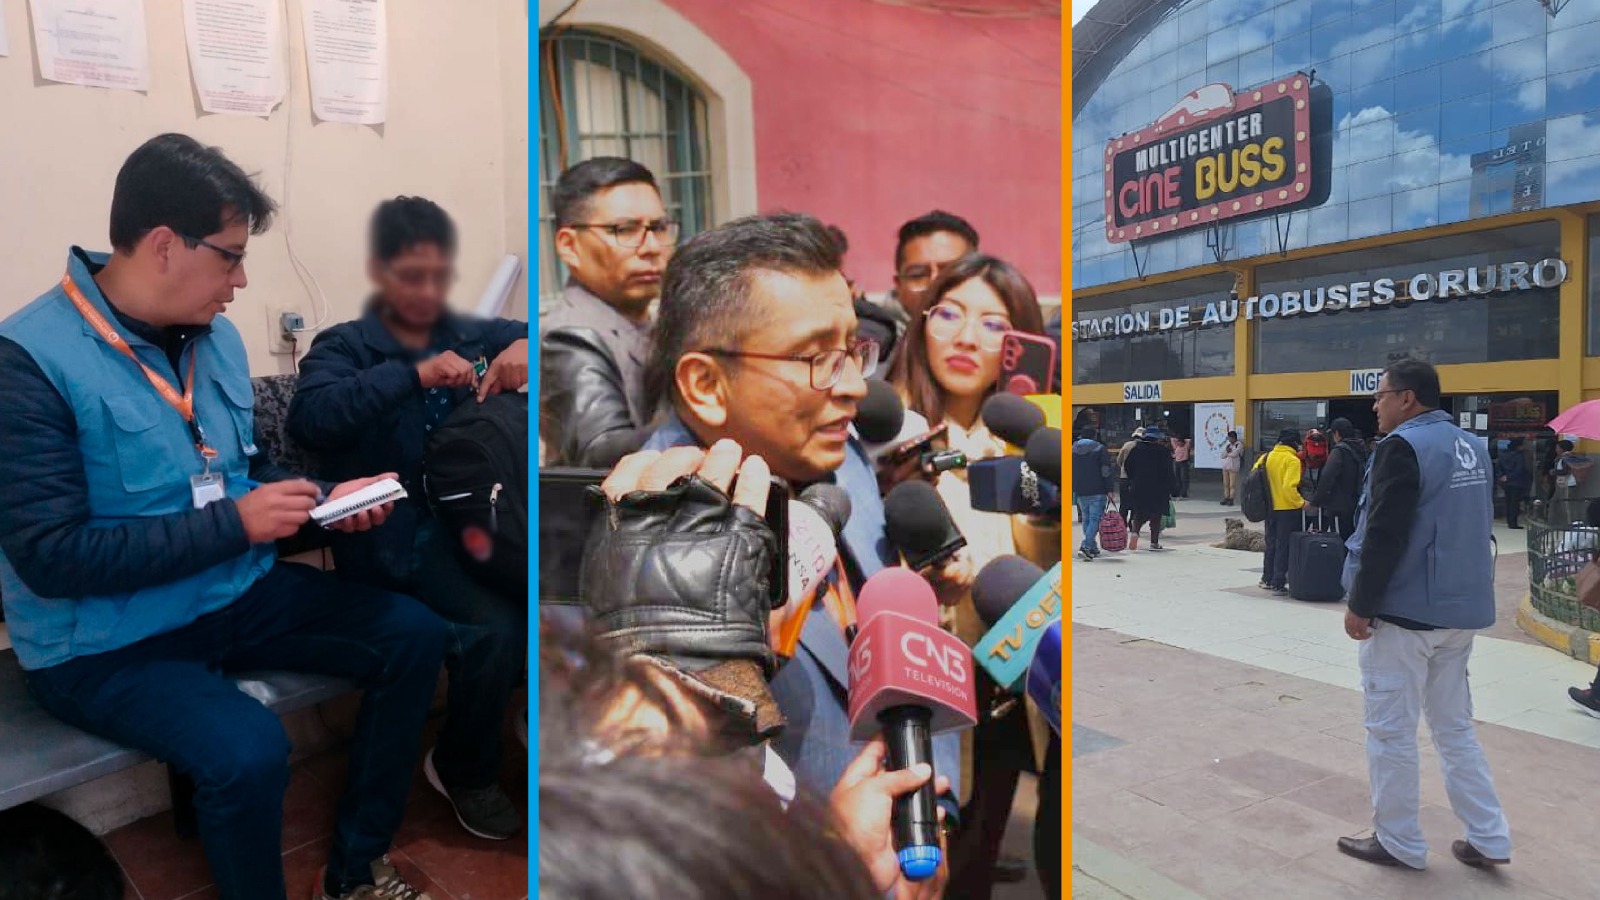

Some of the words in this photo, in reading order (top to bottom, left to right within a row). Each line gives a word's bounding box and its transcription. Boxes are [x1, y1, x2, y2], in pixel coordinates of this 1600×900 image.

[1135, 113, 1263, 172] MULTICENTER
[1118, 166, 1182, 218] CINE
[1195, 136, 1287, 201] BUSS
[1159, 305, 1190, 330] DE
[1201, 278, 1396, 326] AUTOBUSES
[1408, 257, 1567, 301] ORURO
[1124, 384, 1161, 400] SALIDA
[989, 622, 1022, 662] TV
[904, 666, 968, 702] TELEVISION
